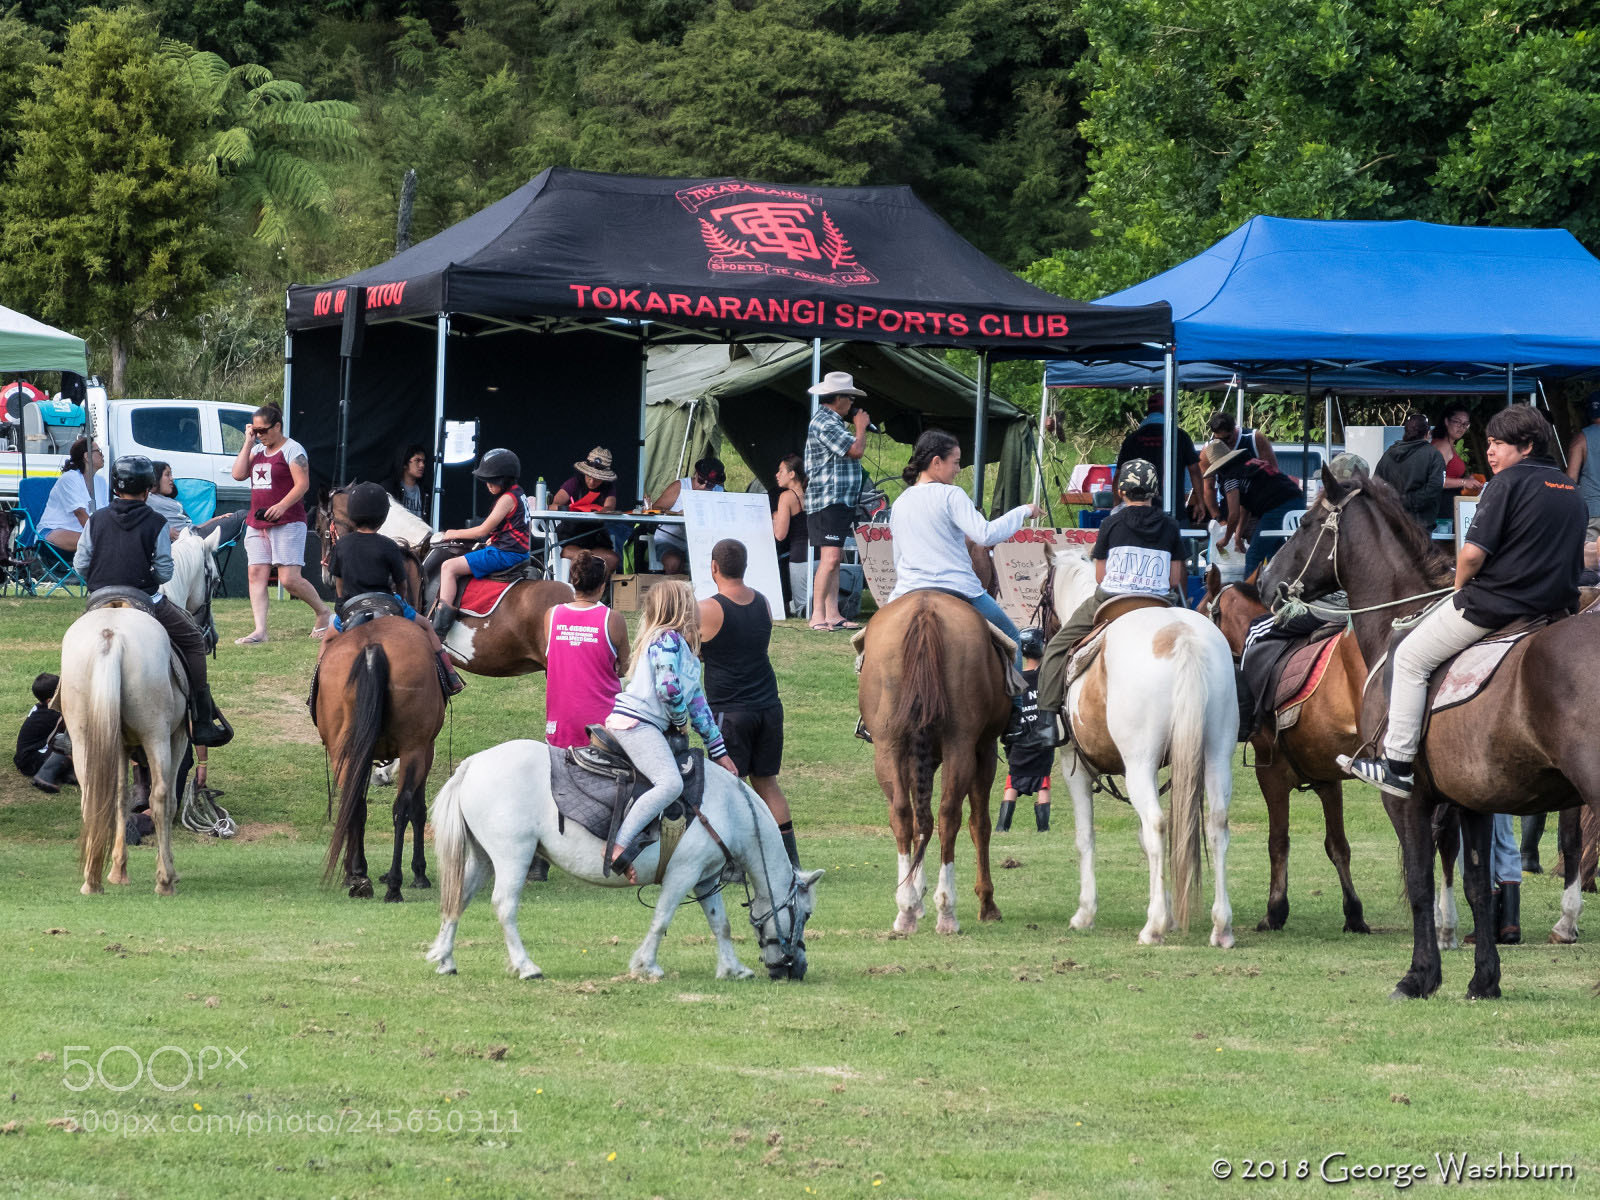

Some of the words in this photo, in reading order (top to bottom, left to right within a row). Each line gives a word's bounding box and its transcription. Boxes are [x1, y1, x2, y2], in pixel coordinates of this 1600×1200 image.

[711, 263, 764, 272] SPORTS
[841, 275, 871, 283] CLUB
[313, 291, 332, 316] KO
[569, 284, 825, 324] TOKARARANGI
[835, 303, 969, 337] SPORTS
[979, 313, 1070, 337] CLUB
